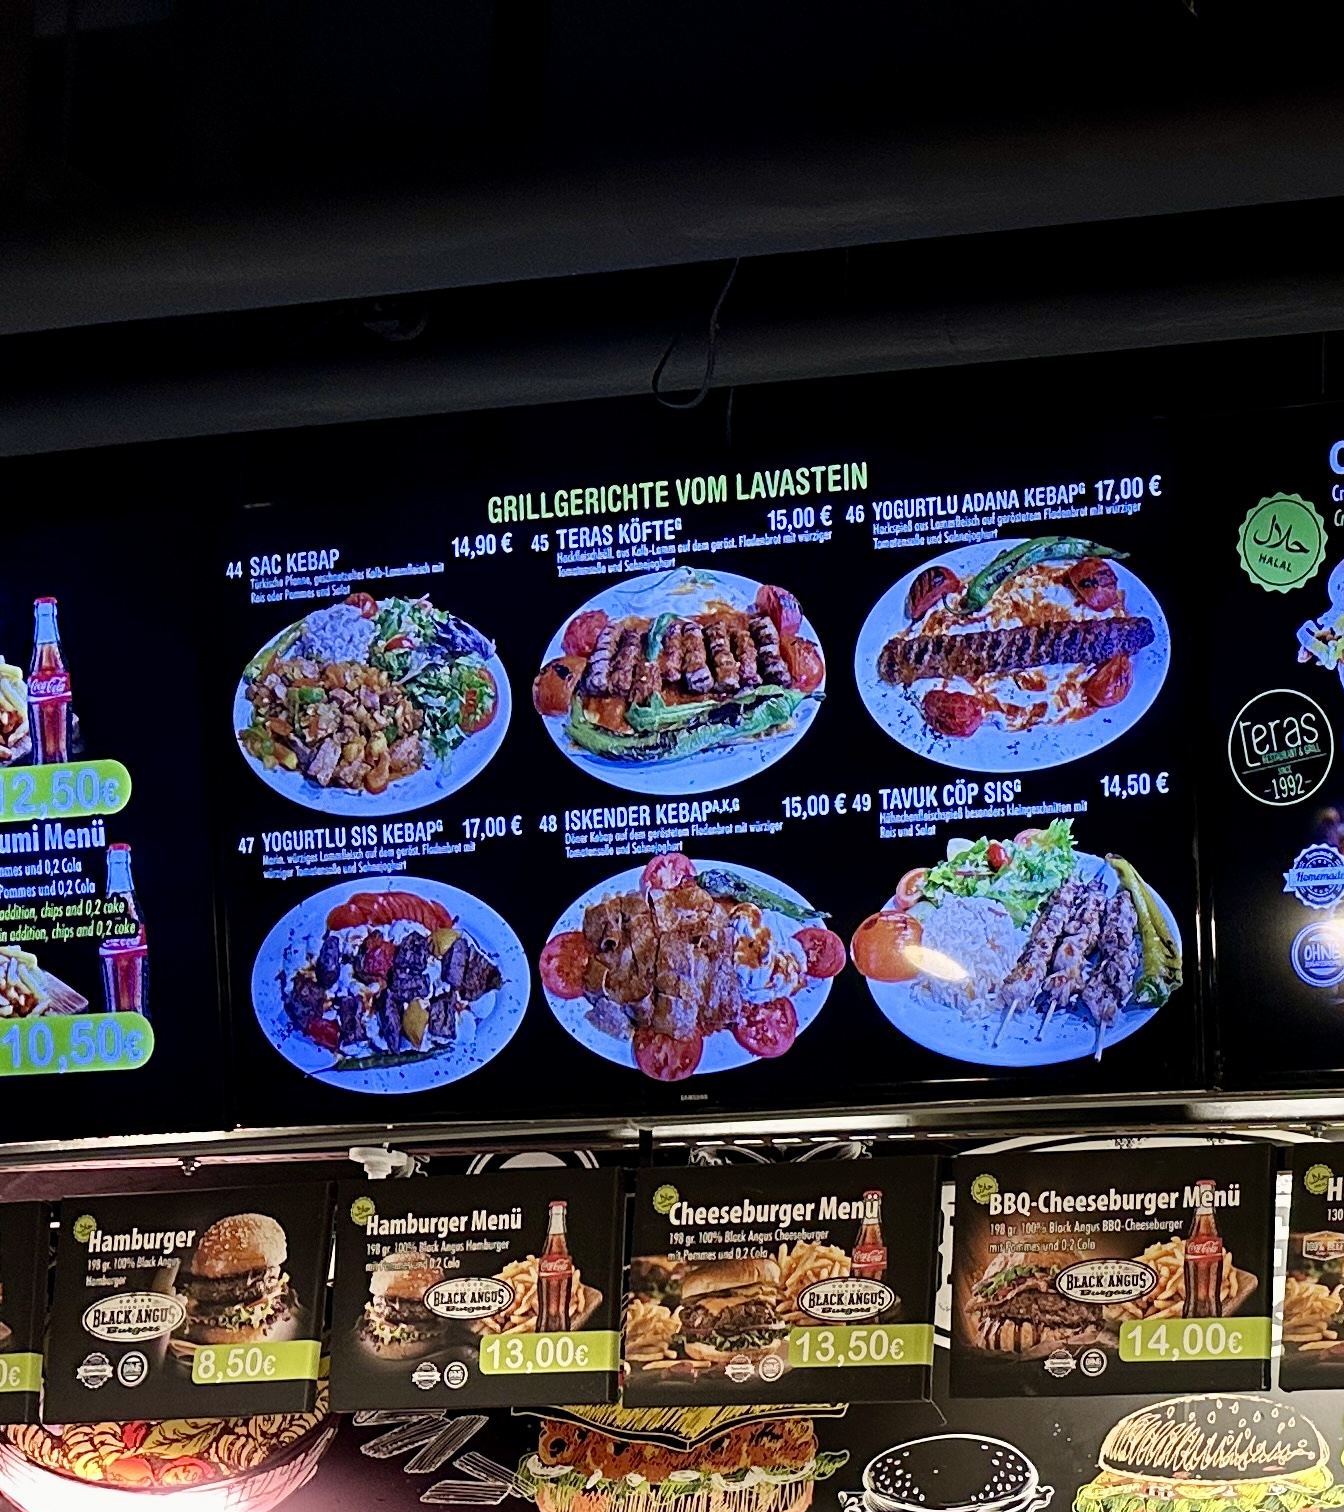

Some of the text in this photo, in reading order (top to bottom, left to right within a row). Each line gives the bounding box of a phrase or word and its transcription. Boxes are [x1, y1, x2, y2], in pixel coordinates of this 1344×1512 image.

[488, 462, 868, 524] GRILLGERICHTE VOM LAVASTEIN
[1094, 475, 1161, 503] 17,00 €
[846, 505, 864, 524] 46
[872, 495, 959, 521] YOGURTLU
[962, 489, 1019, 514] ADANA
[451, 533, 512, 559] 14,90 €
[225, 549, 340, 579] 44 SAC KEBAP
[1258, 553, 1292, 573] HALAL
[1239, 713, 1318, 767] teras
[669, 1192, 880, 1228] Cheeseburger Menü
[989, 1184, 1240, 1216] BBQ-Cheeseburger Menü
[366, 1208, 522, 1238] Hamburger Menü
[88, 1227, 196, 1255] Hamburger
[1066, 1272, 1147, 1288] BLACK ANGUS
[486, 1337, 589, 1373] 13,00€
[795, 1330, 904, 1367] 13,50€
[1127, 1323, 1243, 1361] 14,00€
[198, 1347, 276, 1384] 8,50€
